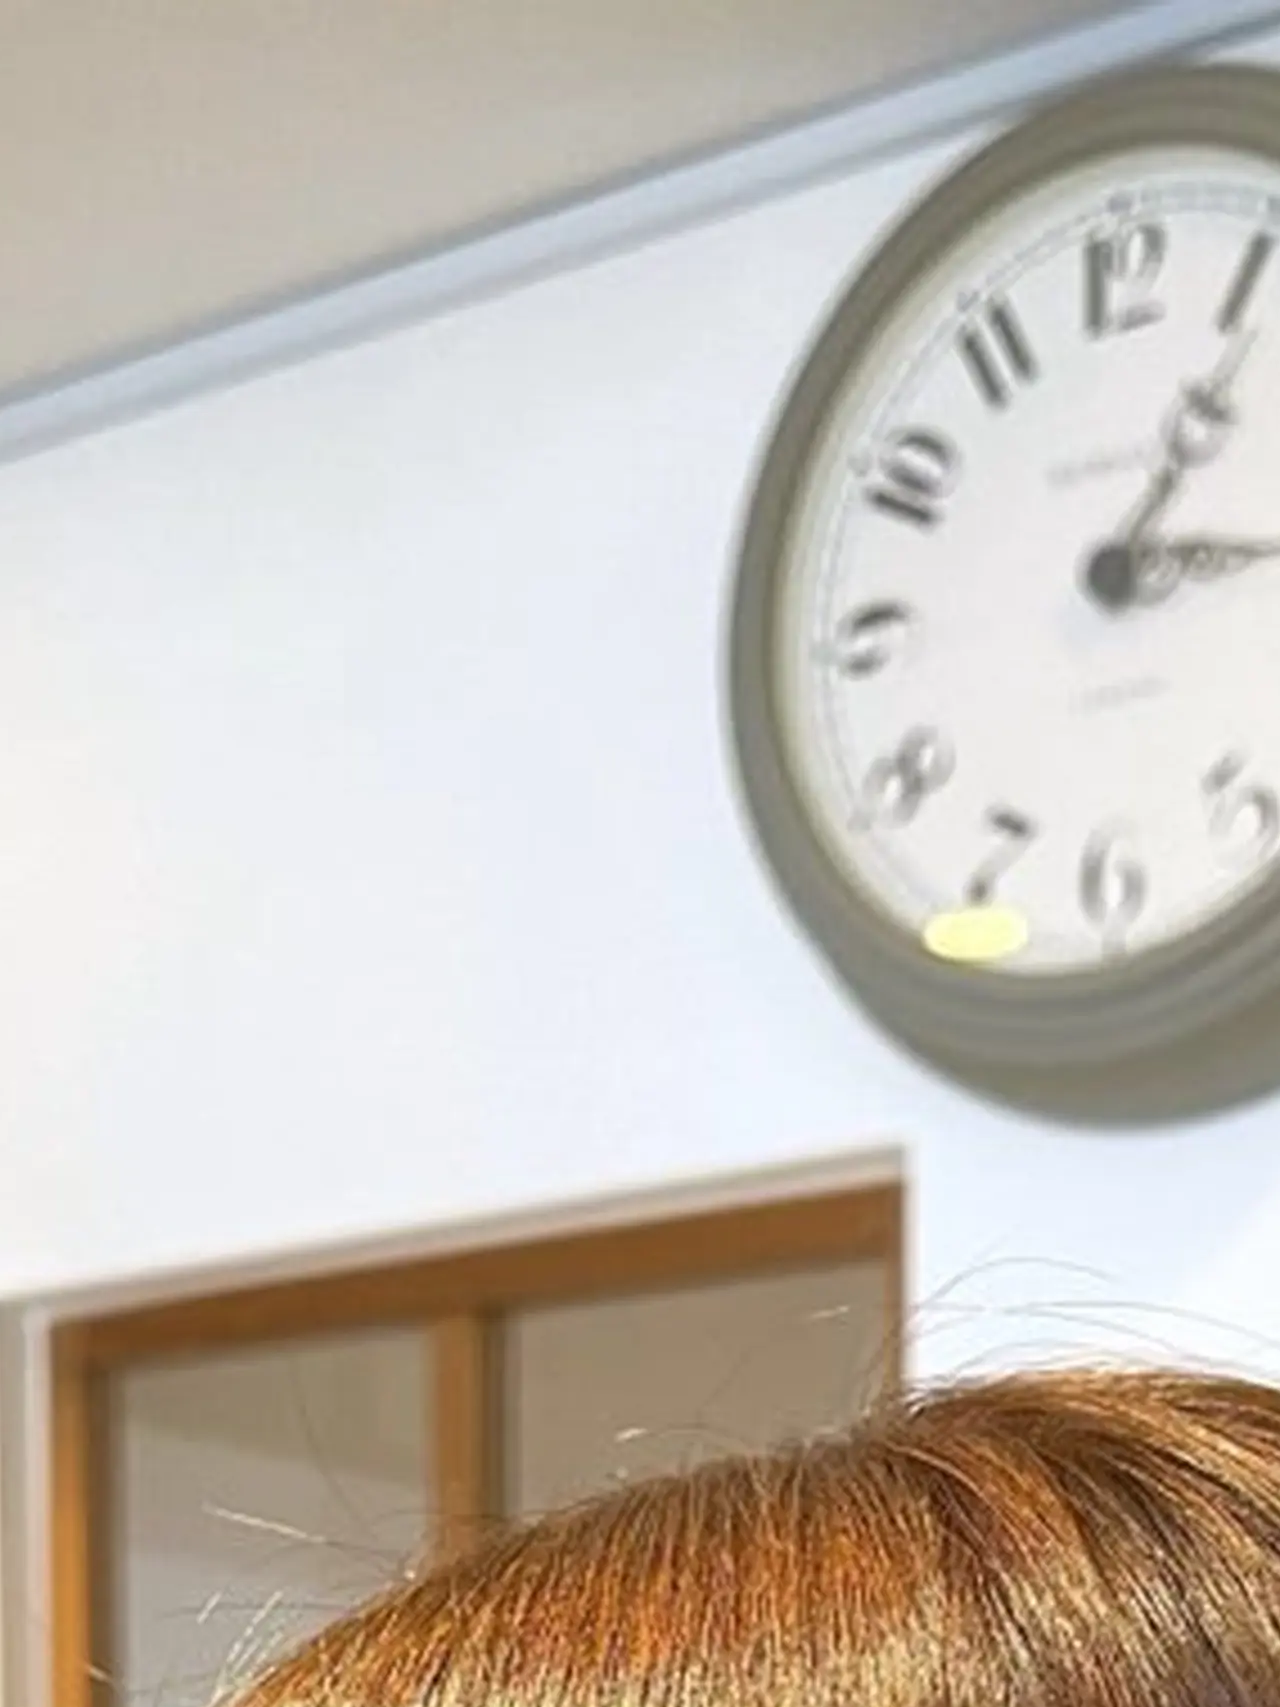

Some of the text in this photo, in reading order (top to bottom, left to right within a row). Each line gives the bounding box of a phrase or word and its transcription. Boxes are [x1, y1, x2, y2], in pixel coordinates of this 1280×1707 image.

[1083, 222, 1167, 339] 12
[1217, 232, 1275, 333] 1
[959, 292, 1037, 410] 11
[867, 426, 961, 529] 10
[836, 600, 916, 680] 9
[862, 724, 957, 829] 8
[1200, 750, 1280, 868] 5
[965, 803, 1040, 904] 7
[1081, 815, 1148, 926] 6
